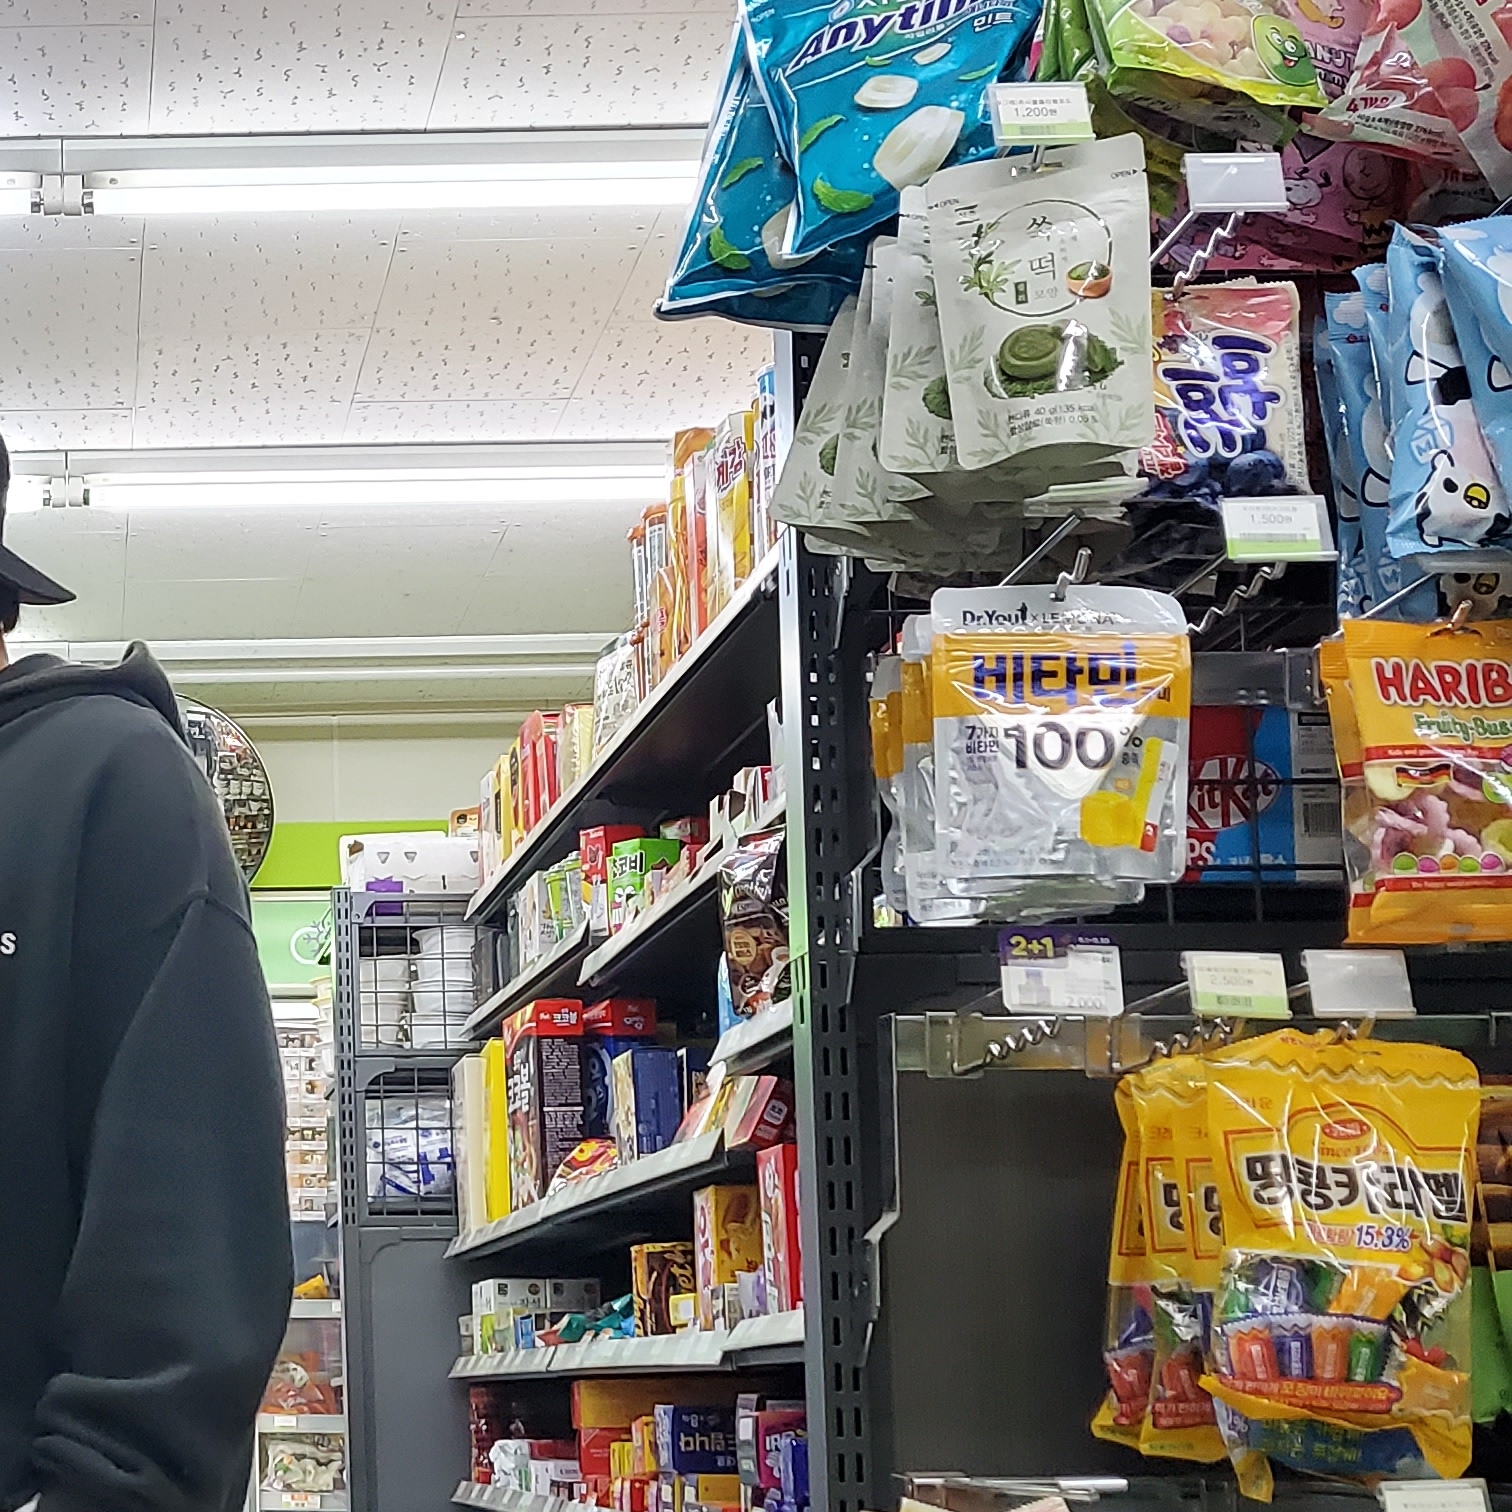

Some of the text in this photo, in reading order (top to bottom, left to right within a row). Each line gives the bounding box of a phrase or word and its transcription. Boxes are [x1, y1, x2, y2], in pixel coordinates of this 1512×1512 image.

[973, 11, 1015, 31] 민트
[1110, 168, 1132, 180] OPEN
[938, 198, 960, 209] OPEN
[1029, 252, 1056, 281] 떡
[972, 640, 1138, 709] 비타민
[965, 740, 1000, 754] 비타민
[1009, 935, 1055, 957] 2+1
